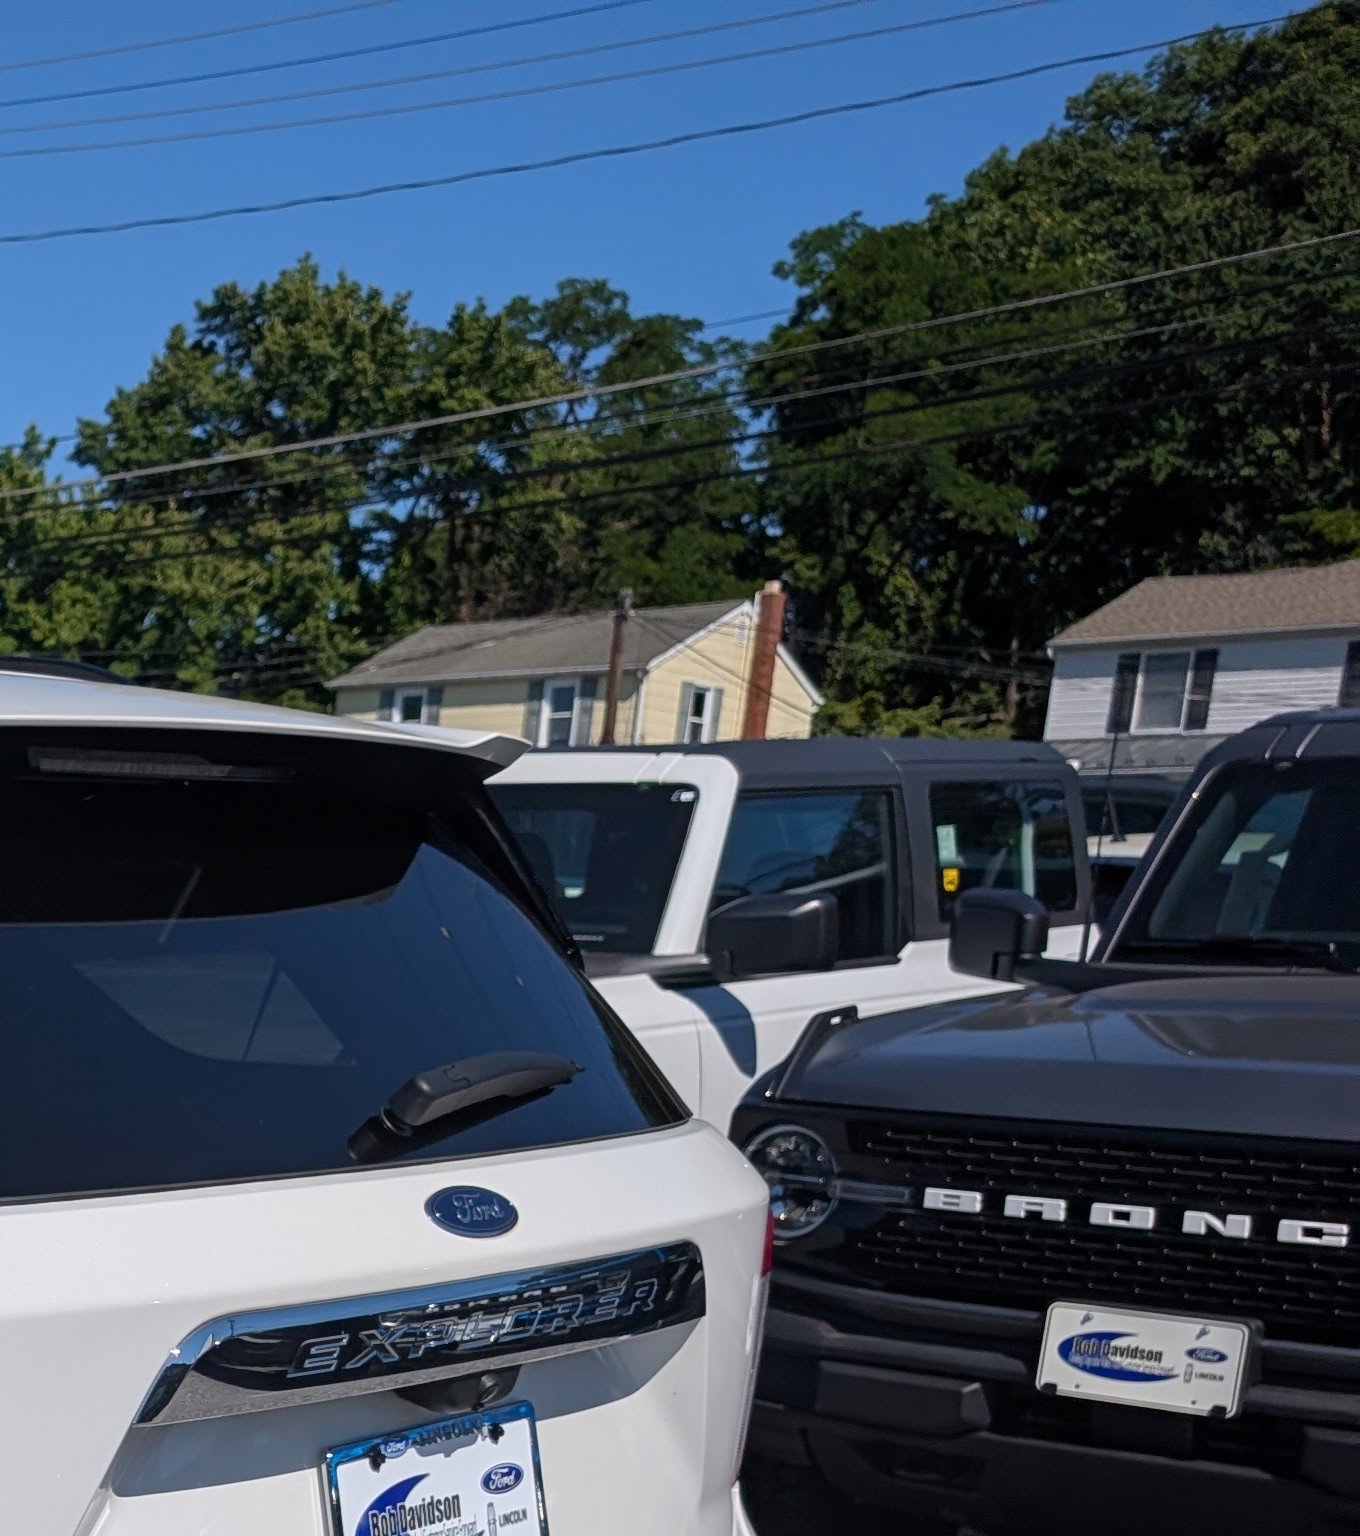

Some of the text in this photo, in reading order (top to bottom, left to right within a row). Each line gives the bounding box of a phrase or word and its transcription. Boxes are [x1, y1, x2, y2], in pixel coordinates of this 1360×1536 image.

[452, 1193, 505, 1223] Ford
[286, 1277, 658, 1378] EXPLORER
[1074, 1336, 1100, 1357] Bob
[1102, 1338, 1163, 1363] Davidson
[489, 1468, 516, 1490] Ford
[399, 1494, 461, 1533] Davidson
[498, 1507, 528, 1527] LINCOLN
